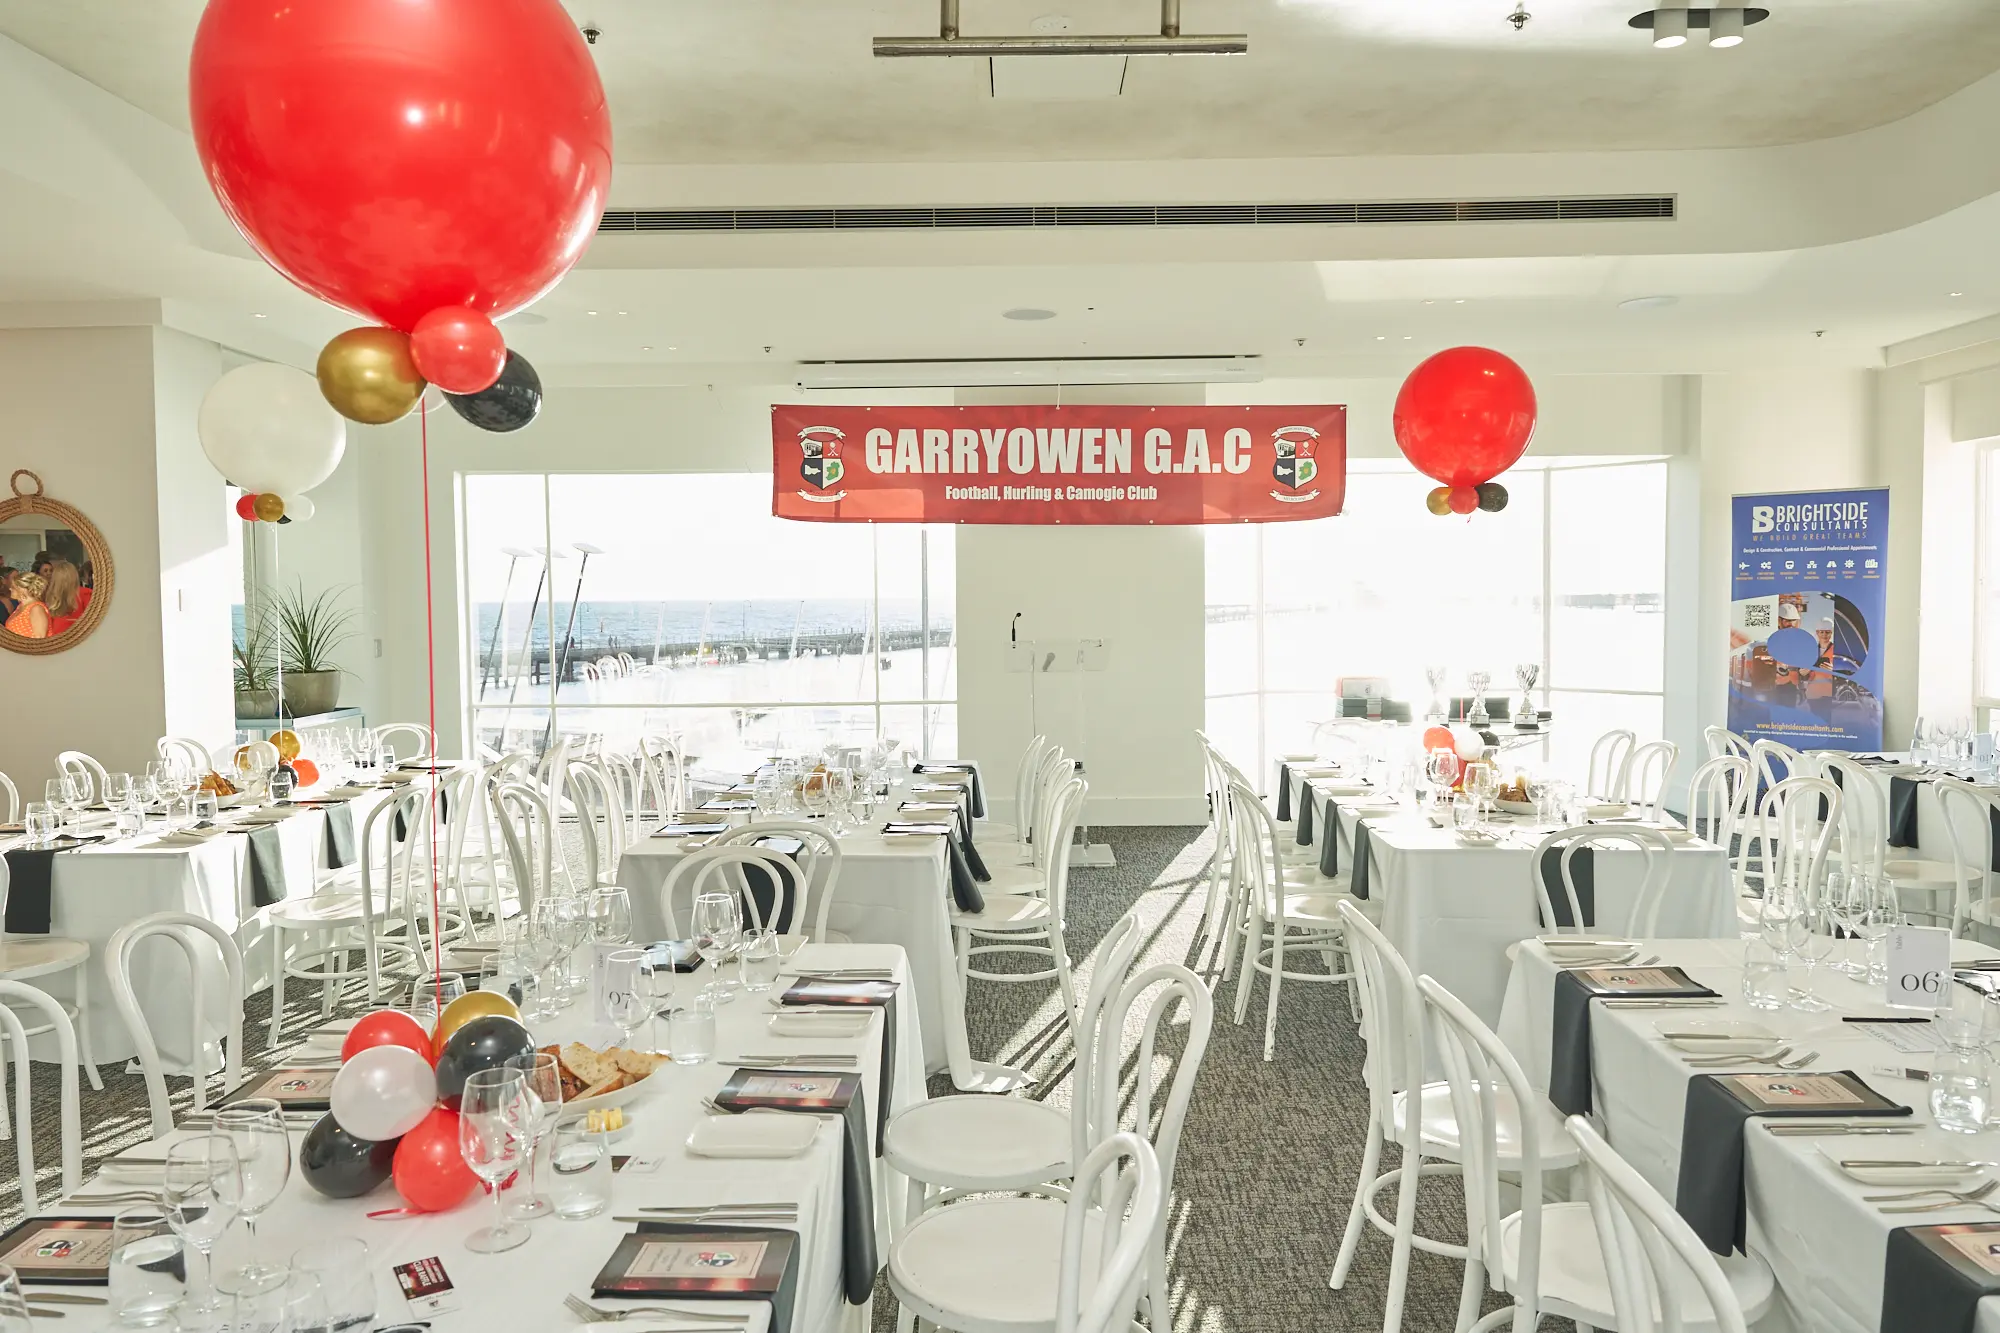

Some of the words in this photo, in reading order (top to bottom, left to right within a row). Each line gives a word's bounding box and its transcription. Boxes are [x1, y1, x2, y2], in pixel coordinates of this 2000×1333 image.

[865, 427, 1131, 474] GARRYOWEN
[1144, 427, 1251, 474] G.A.C
[945, 485, 1001, 502] Football,
[1003, 485, 1051, 502] Hurling
[1054, 486, 1064, 501] &
[1066, 485, 1124, 502] Camogie
[1127, 485, 1157, 501] Club
[1776, 502, 1869, 523] BRIGHTSIDE
[1776, 519, 1868, 532] CONSULTANTS
[1752, 534, 1764, 542] WE
[1770, 533, 1797, 541] BUILD
[1803, 532, 1831, 541] GREAT
[1837, 531, 1867, 540] TEAMS
[1756, 722, 1844, 733] www.brightsideconsultants.com
[1900, 970, 1940, 994] 06
[609, 990, 632, 1010] 07
